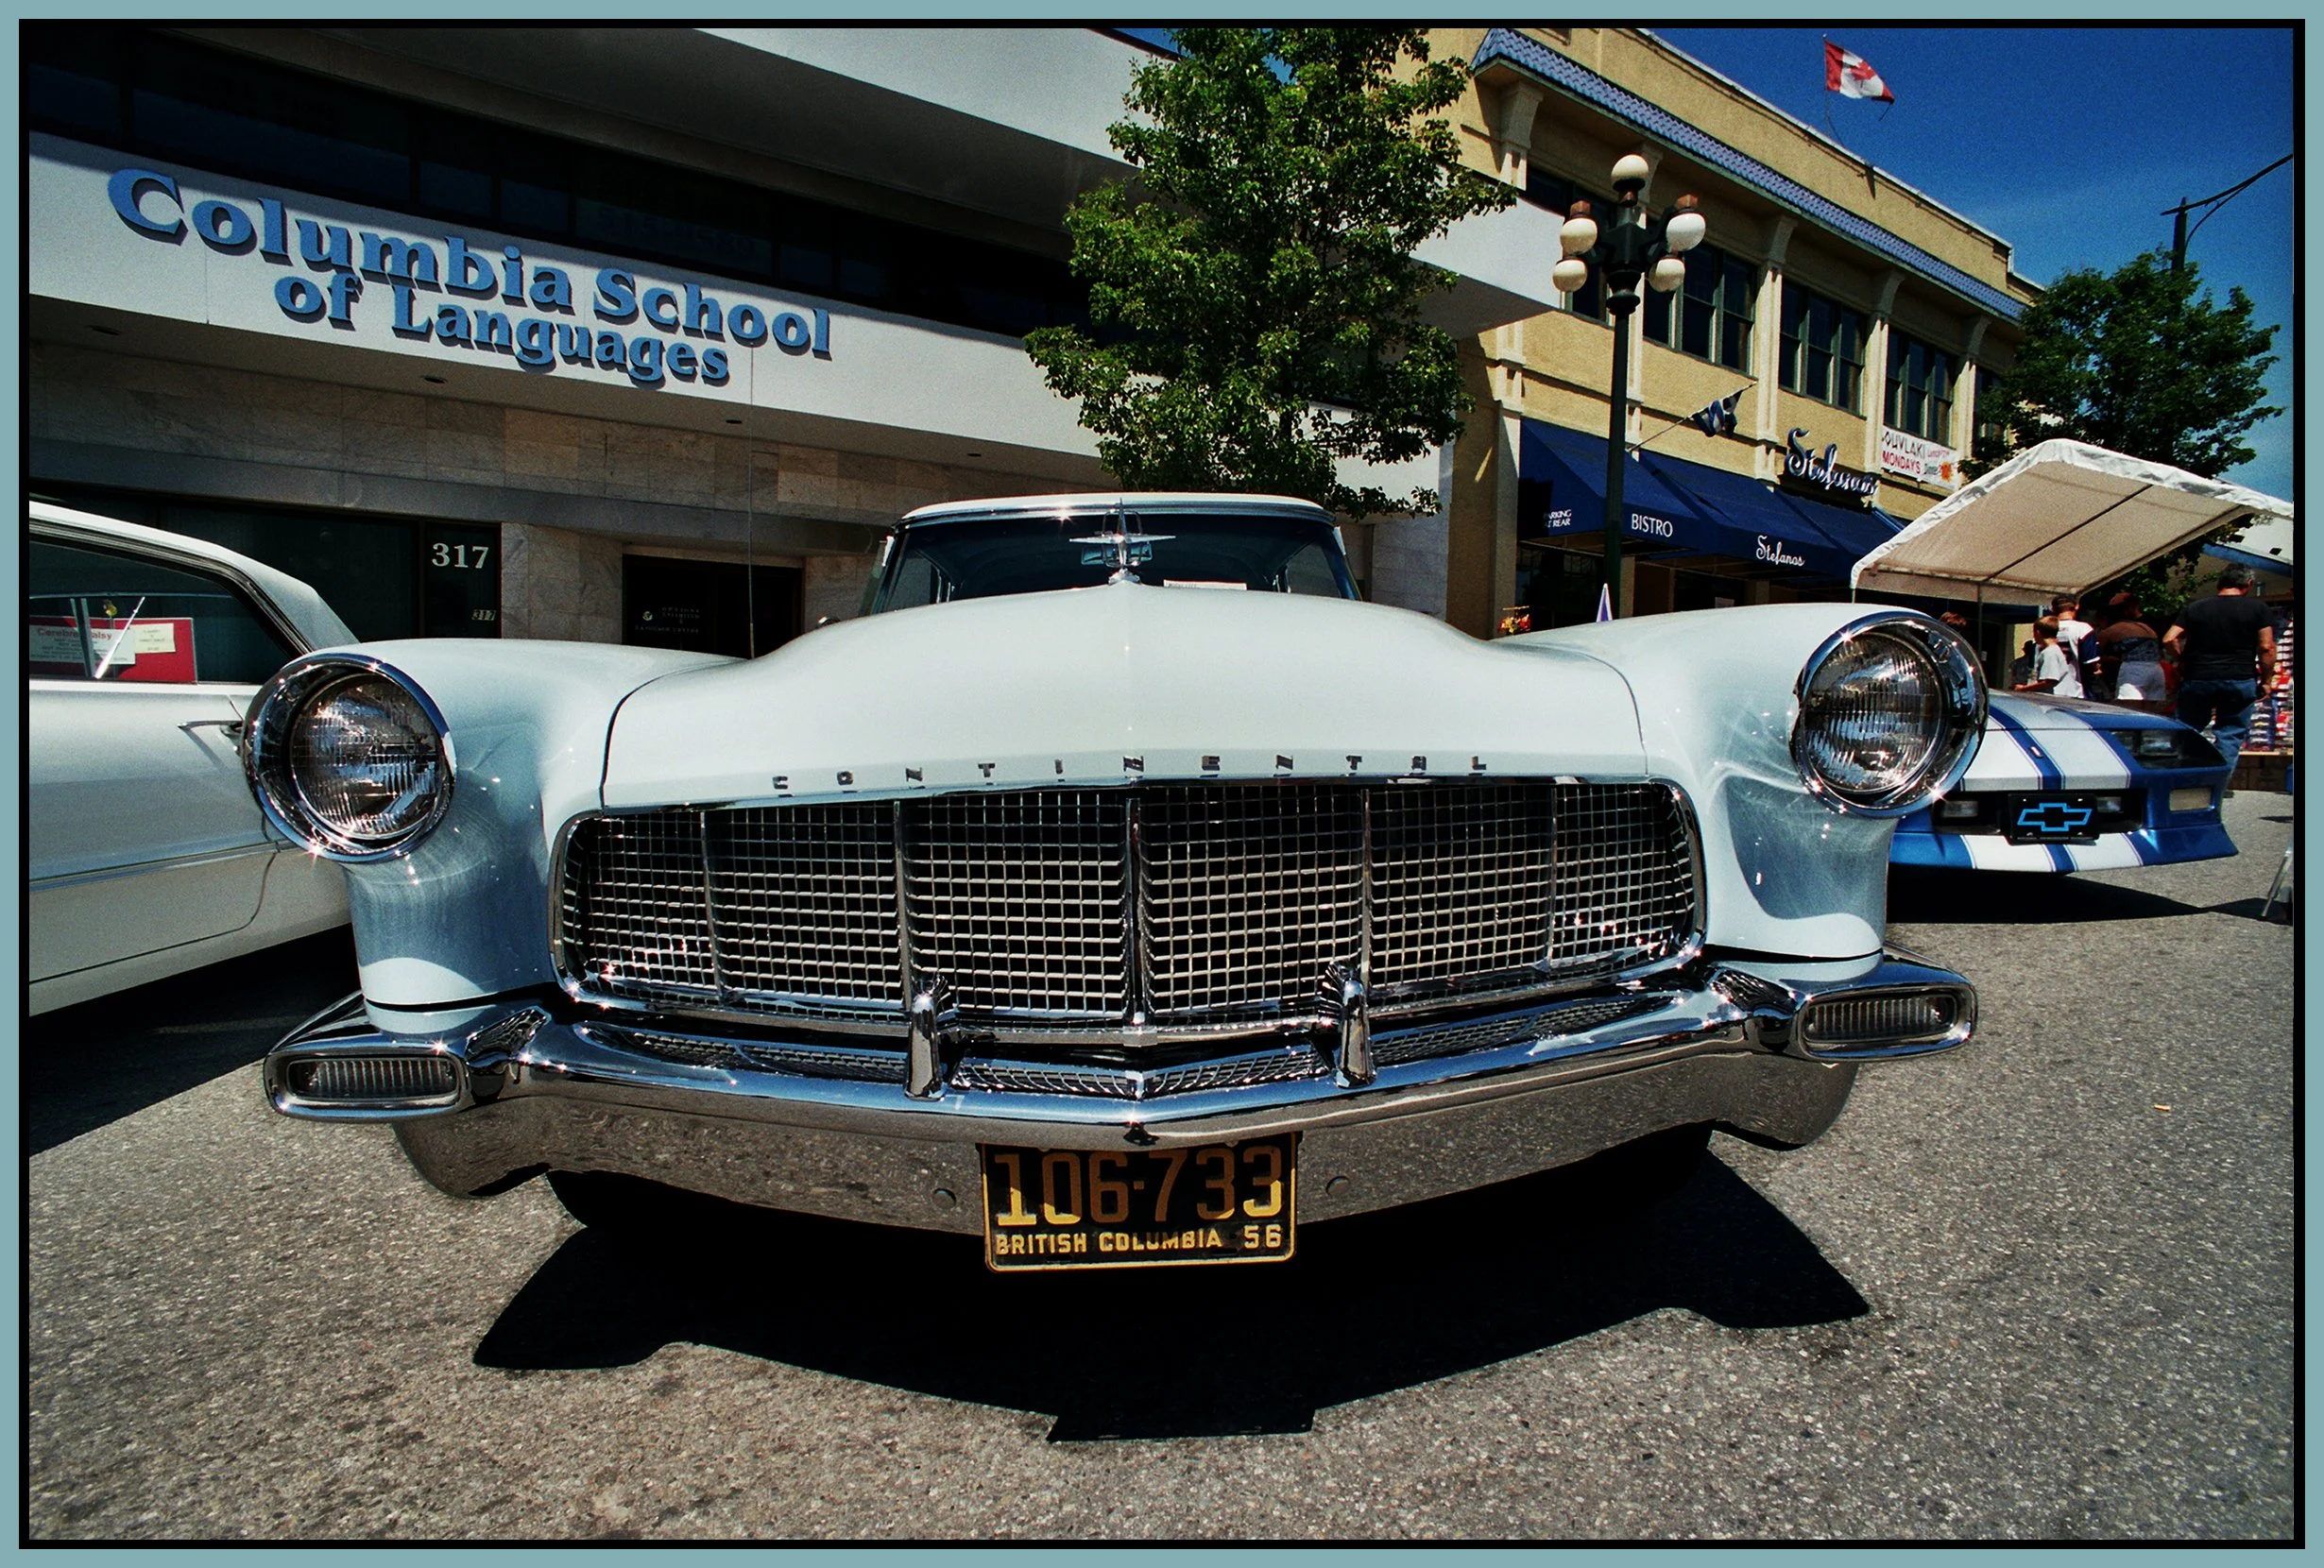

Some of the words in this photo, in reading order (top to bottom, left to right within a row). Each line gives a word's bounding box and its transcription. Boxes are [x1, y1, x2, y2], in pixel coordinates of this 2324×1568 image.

[108, 168, 573, 313] Columbia
[593, 267, 831, 359] School
[275, 273, 363, 330] of
[392, 284, 730, 389] Languages
[1881, 431, 1925, 459] OUVLAKI
[1882, 451, 1922, 475] MONDAYS
[1552, 518, 1572, 528] REAR
[1632, 513, 1673, 537] BISTRO
[431, 541, 489, 570] 317
[1755, 535, 1805, 567] Stefanos
[91, 631, 112, 641] alsy
[772, 755, 1486, 790] CONTINENTAL
[994, 1144, 1283, 1227] 106-733
[996, 1232, 1087, 1256] BRITISH
[1099, 1227, 1222, 1253] COLUMBIA
[1243, 1224, 1282, 1250] 56
